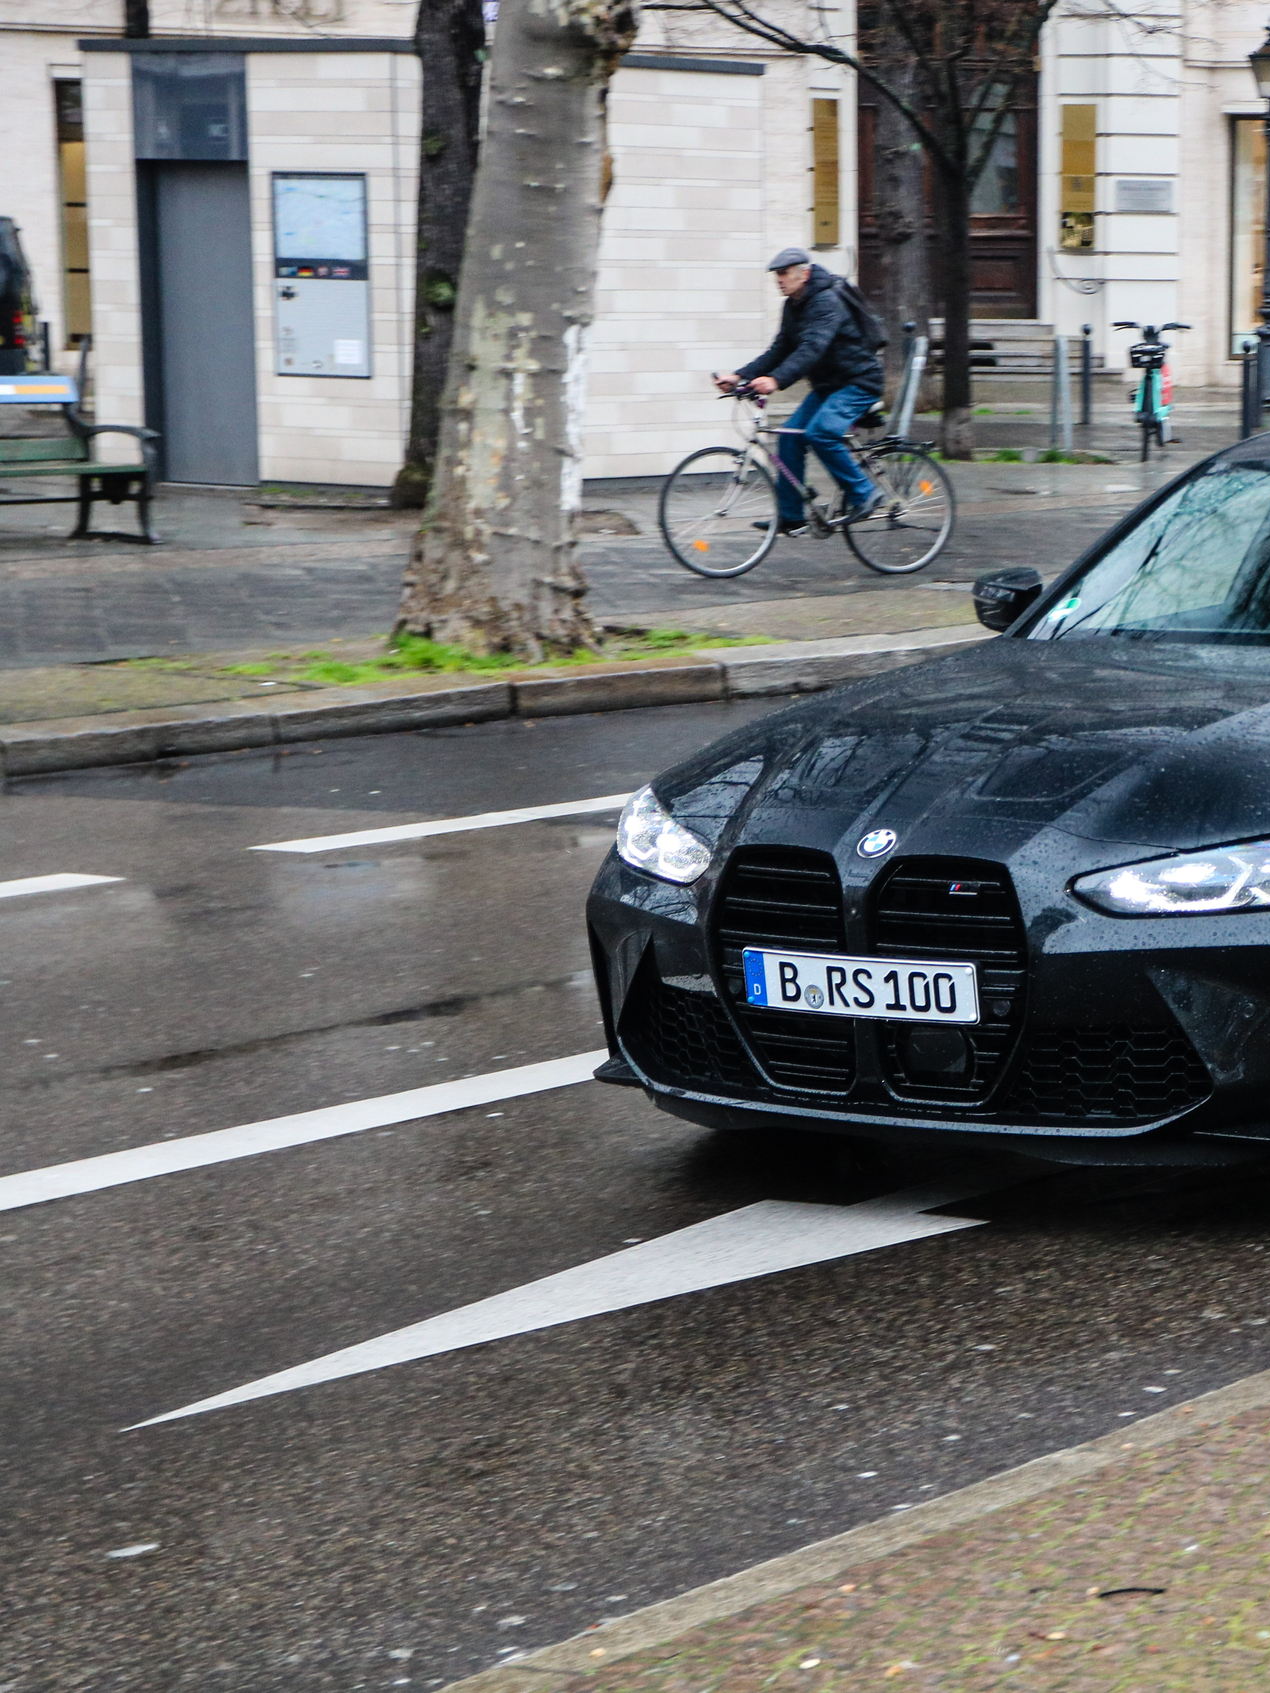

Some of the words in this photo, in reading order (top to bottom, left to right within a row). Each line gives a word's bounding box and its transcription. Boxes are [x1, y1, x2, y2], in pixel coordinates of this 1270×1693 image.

[753, 984, 762, 995] D
[779, 961, 802, 1002] B
[826, 965, 876, 1009] RS
[883, 970, 957, 1014] 100
